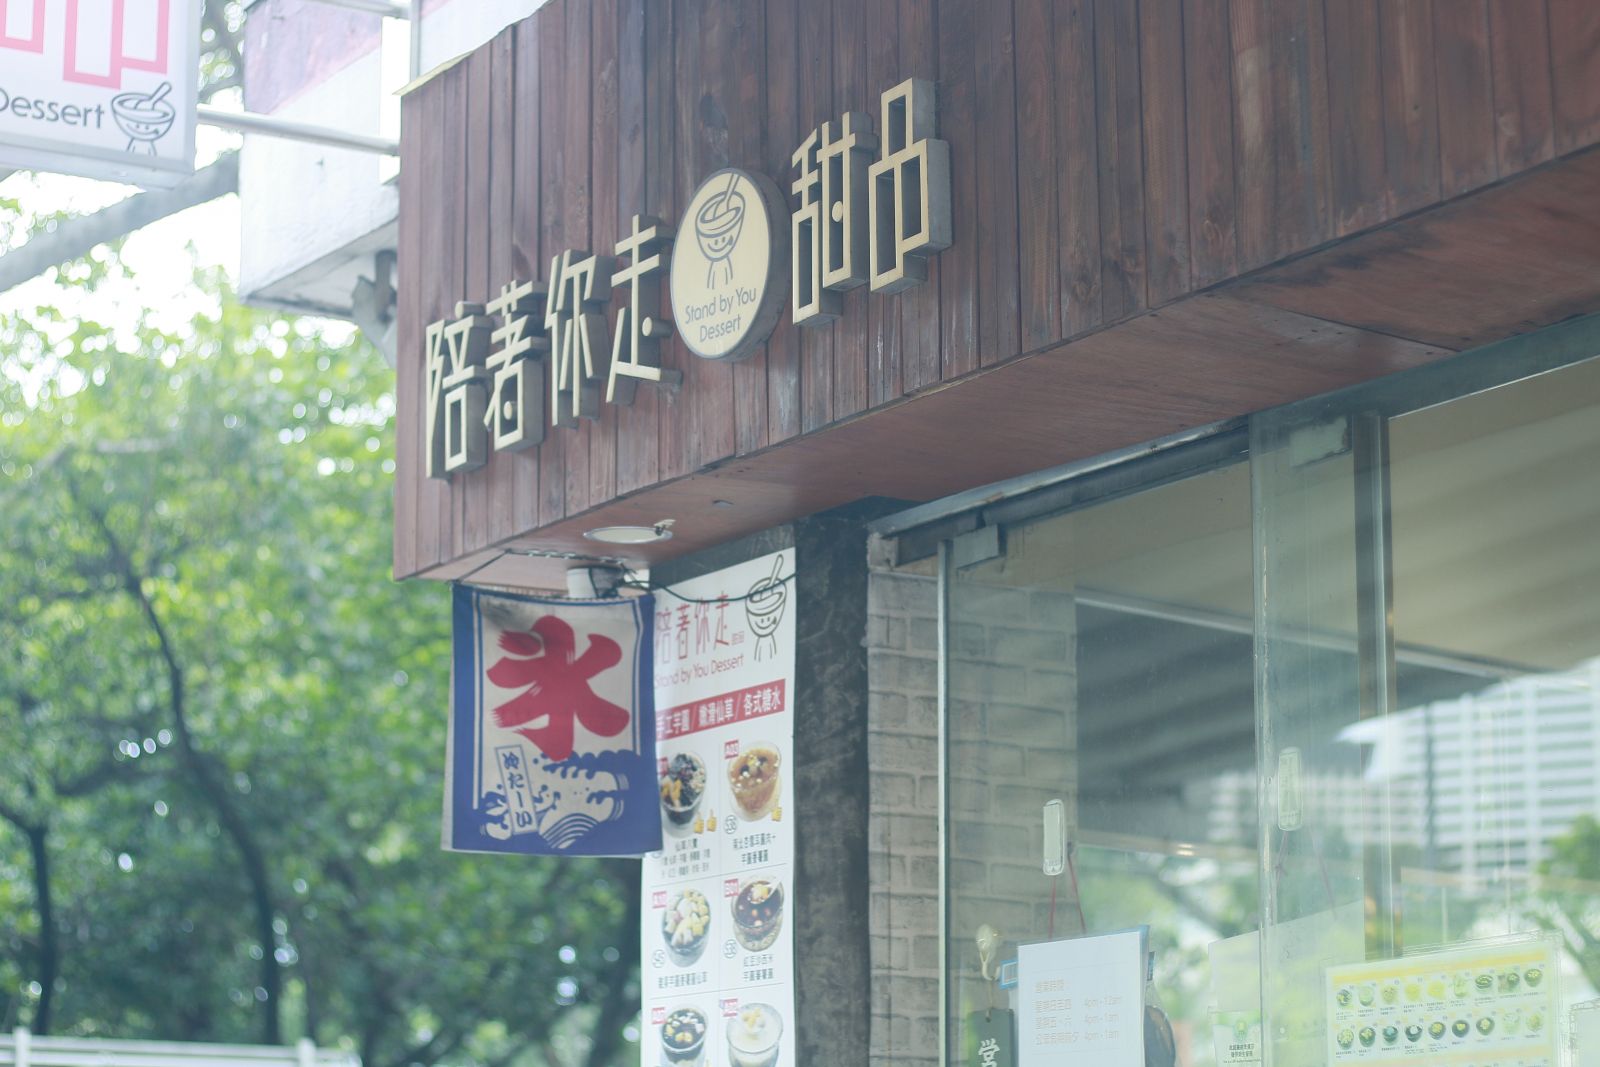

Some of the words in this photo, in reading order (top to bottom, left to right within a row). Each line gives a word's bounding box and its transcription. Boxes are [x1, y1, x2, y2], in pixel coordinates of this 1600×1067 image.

[426, 214, 661, 479] 陪著你走
[792, 77, 929, 325] 甜品
[685, 297, 716, 325] Stand
[719, 294, 734, 315] by
[735, 287, 757, 307] You
[699, 313, 741, 342] Dessert
[693, 662, 710, 678] You
[711, 654, 744, 675] Dessert
[487, 615, 630, 762] 氷
